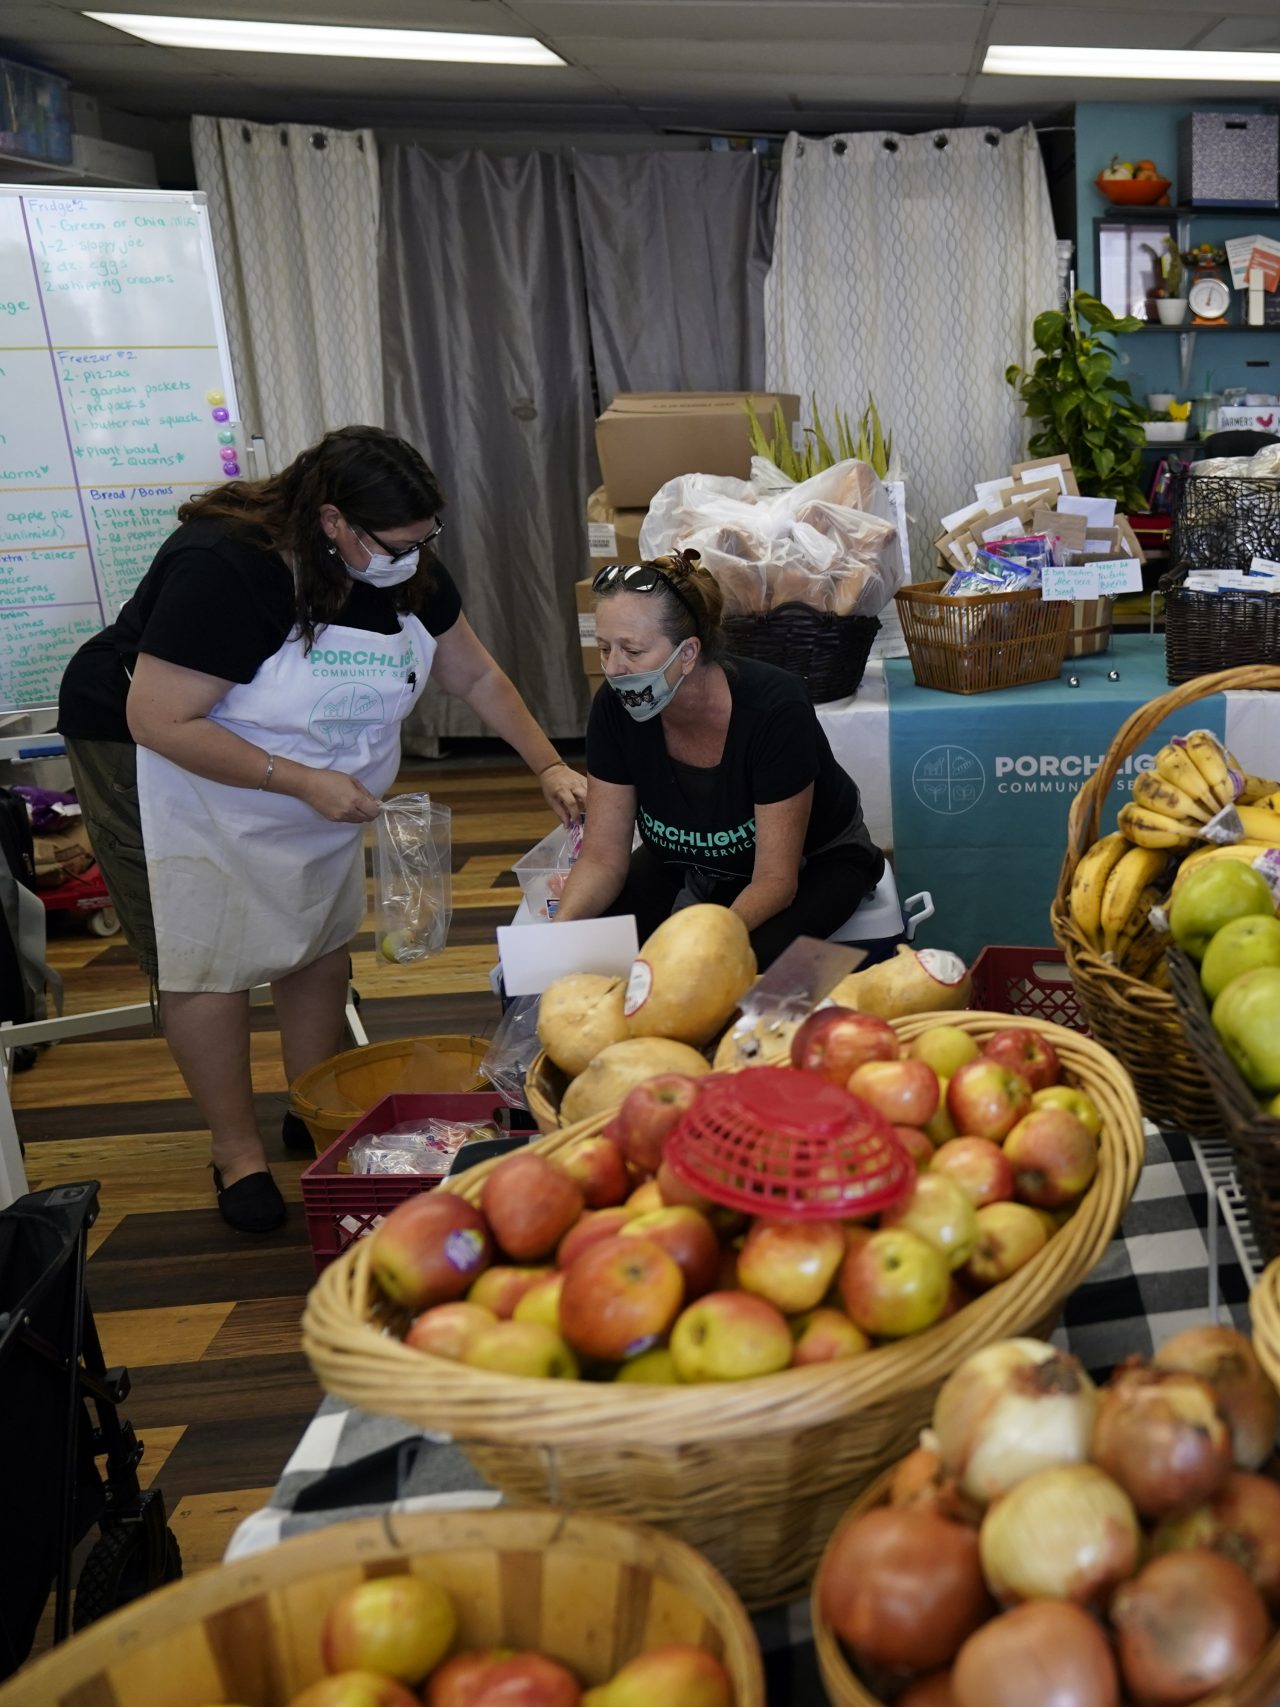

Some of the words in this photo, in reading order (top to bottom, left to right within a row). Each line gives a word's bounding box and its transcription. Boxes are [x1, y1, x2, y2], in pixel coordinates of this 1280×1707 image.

[57, 351, 113, 365] Freezer
[84, 369, 130, 383] pizzas
[310, 647, 413, 668] PORCHLI
[312, 669, 387, 677] COMMUNITY
[995, 754, 1156, 778] PORCHIG
[997, 781, 1084, 794] COMMUN
[640, 803, 756, 848] ORCHLIGHT
[639, 820, 698, 856] OMMUNITY
